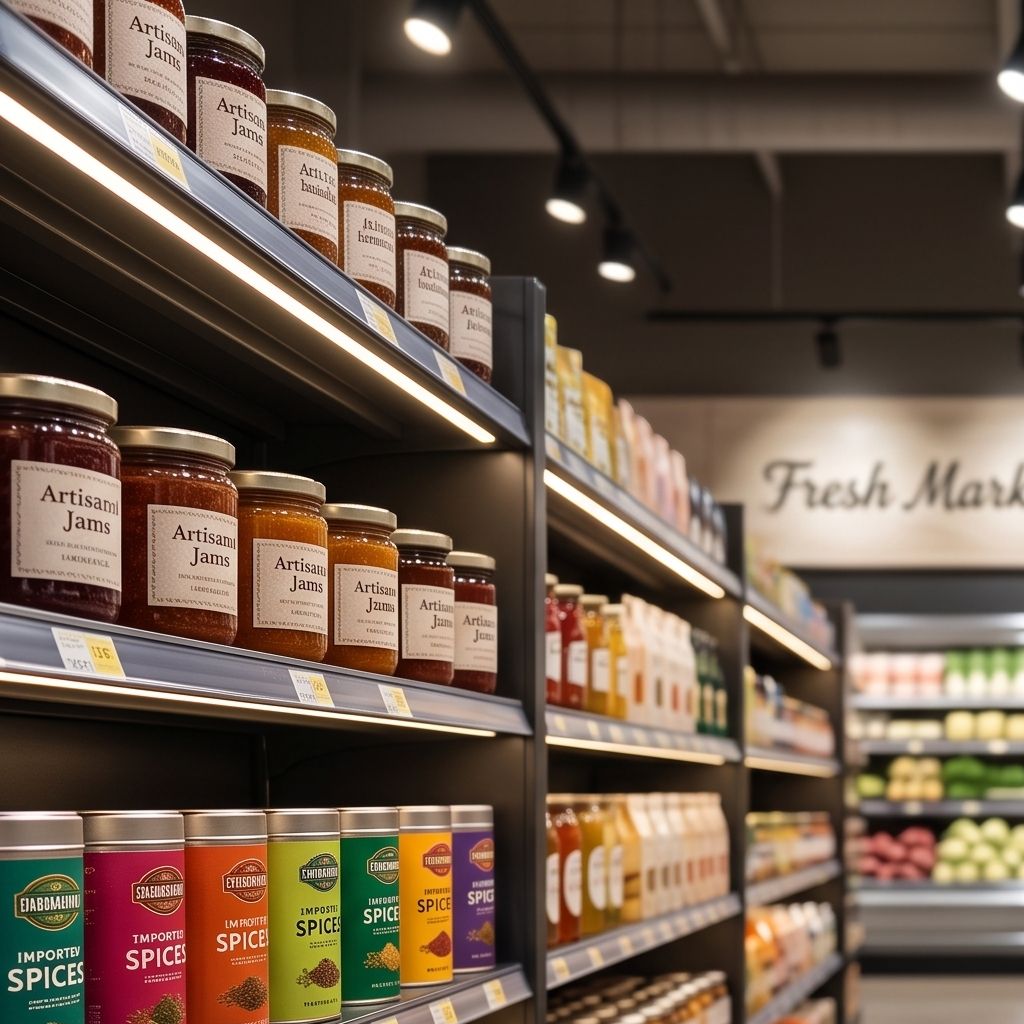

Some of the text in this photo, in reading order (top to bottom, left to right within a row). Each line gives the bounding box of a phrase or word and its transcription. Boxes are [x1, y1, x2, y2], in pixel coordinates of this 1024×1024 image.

[145, 39, 181, 72] Jams
[232, 118, 264, 146] Jams
[762, 459, 890, 515] Fresh
[63, 510, 111, 535] Jams
[190, 546, 230, 568] Jams
[289, 576, 323, 594] Jams
[126, 943, 186, 970] SPICES
[8, 960, 84, 993] SPICES
